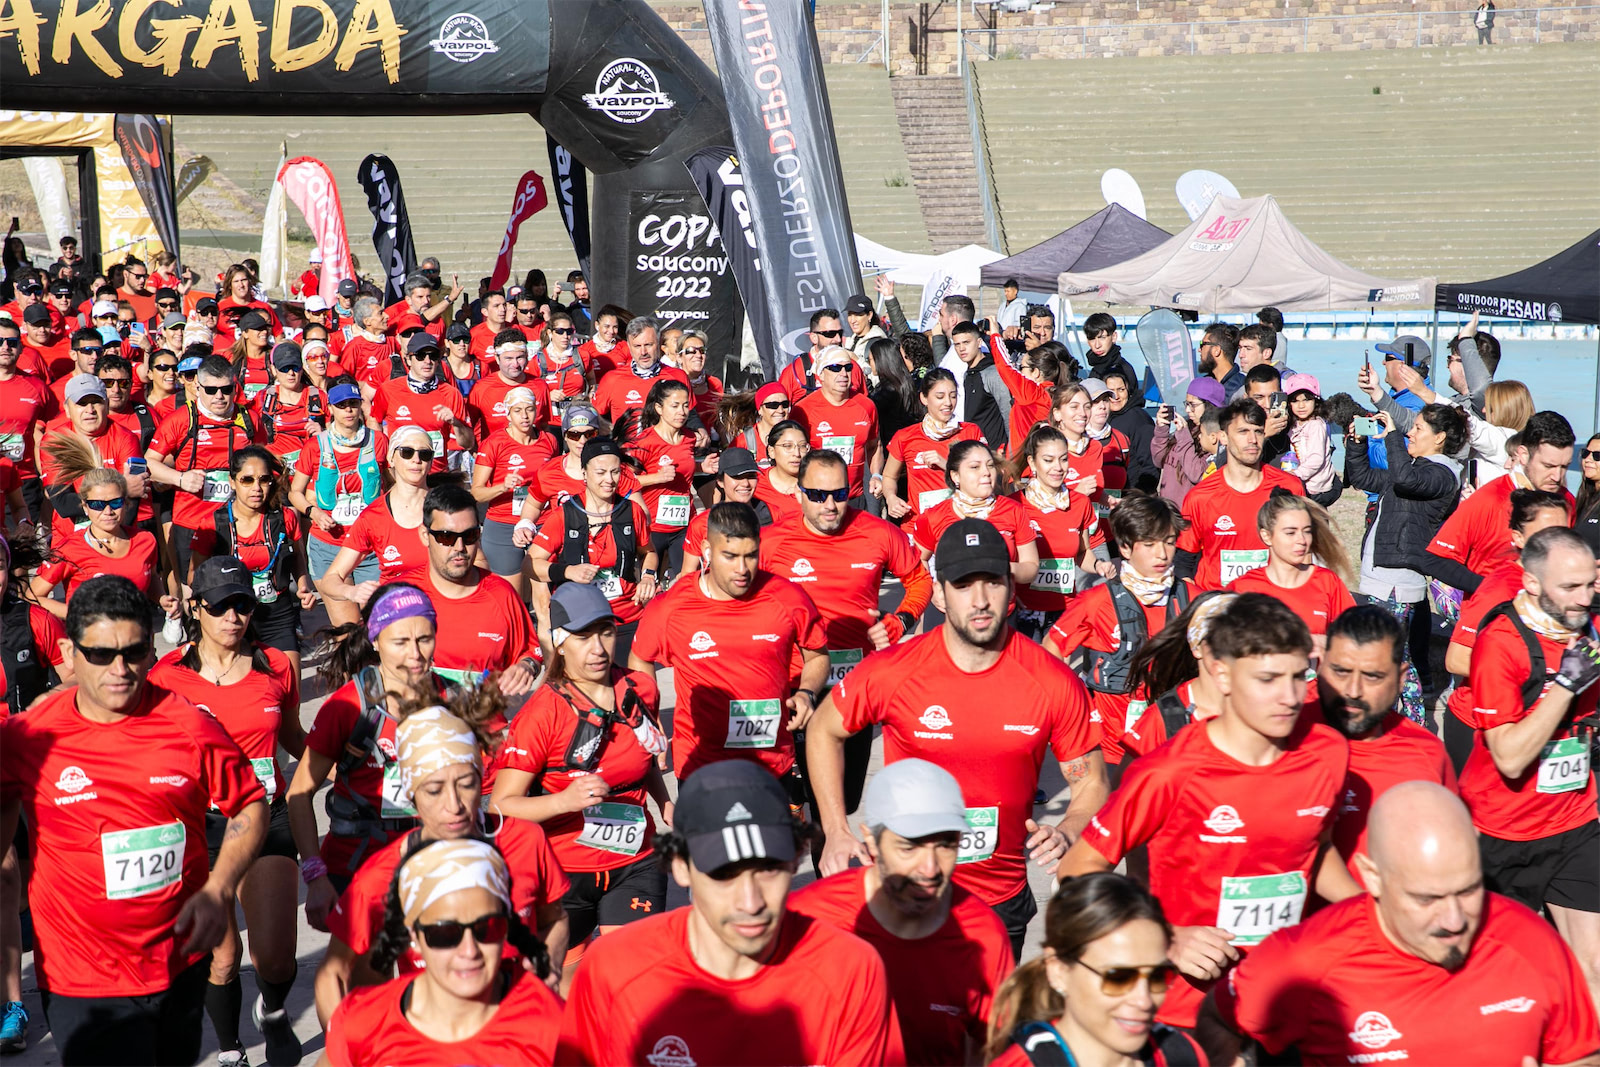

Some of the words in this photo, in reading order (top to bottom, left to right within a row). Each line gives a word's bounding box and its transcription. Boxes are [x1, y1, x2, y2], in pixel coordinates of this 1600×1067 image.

[602, 64, 634, 86] NATURAL
[634, 66, 653, 84] RACE
[636, 254, 728, 275] saucony
[655, 276, 711, 298] 2022
[1458, 293, 1498, 307] OUTDOOR
[1499, 298, 1546, 320] PESARI
[662, 507, 686, 518] 7173
[1038, 572, 1069, 585] 7090
[393, 595, 423, 610] TRIBU
[733, 704, 747, 713] 7K
[736, 719, 773, 737] 7027
[586, 805, 603, 815] 7K
[591, 822, 637, 844] 7016
[116, 850, 176, 881] 7120
[1227, 883, 1251, 895] 7K
[1233, 902, 1292, 927] 7114
